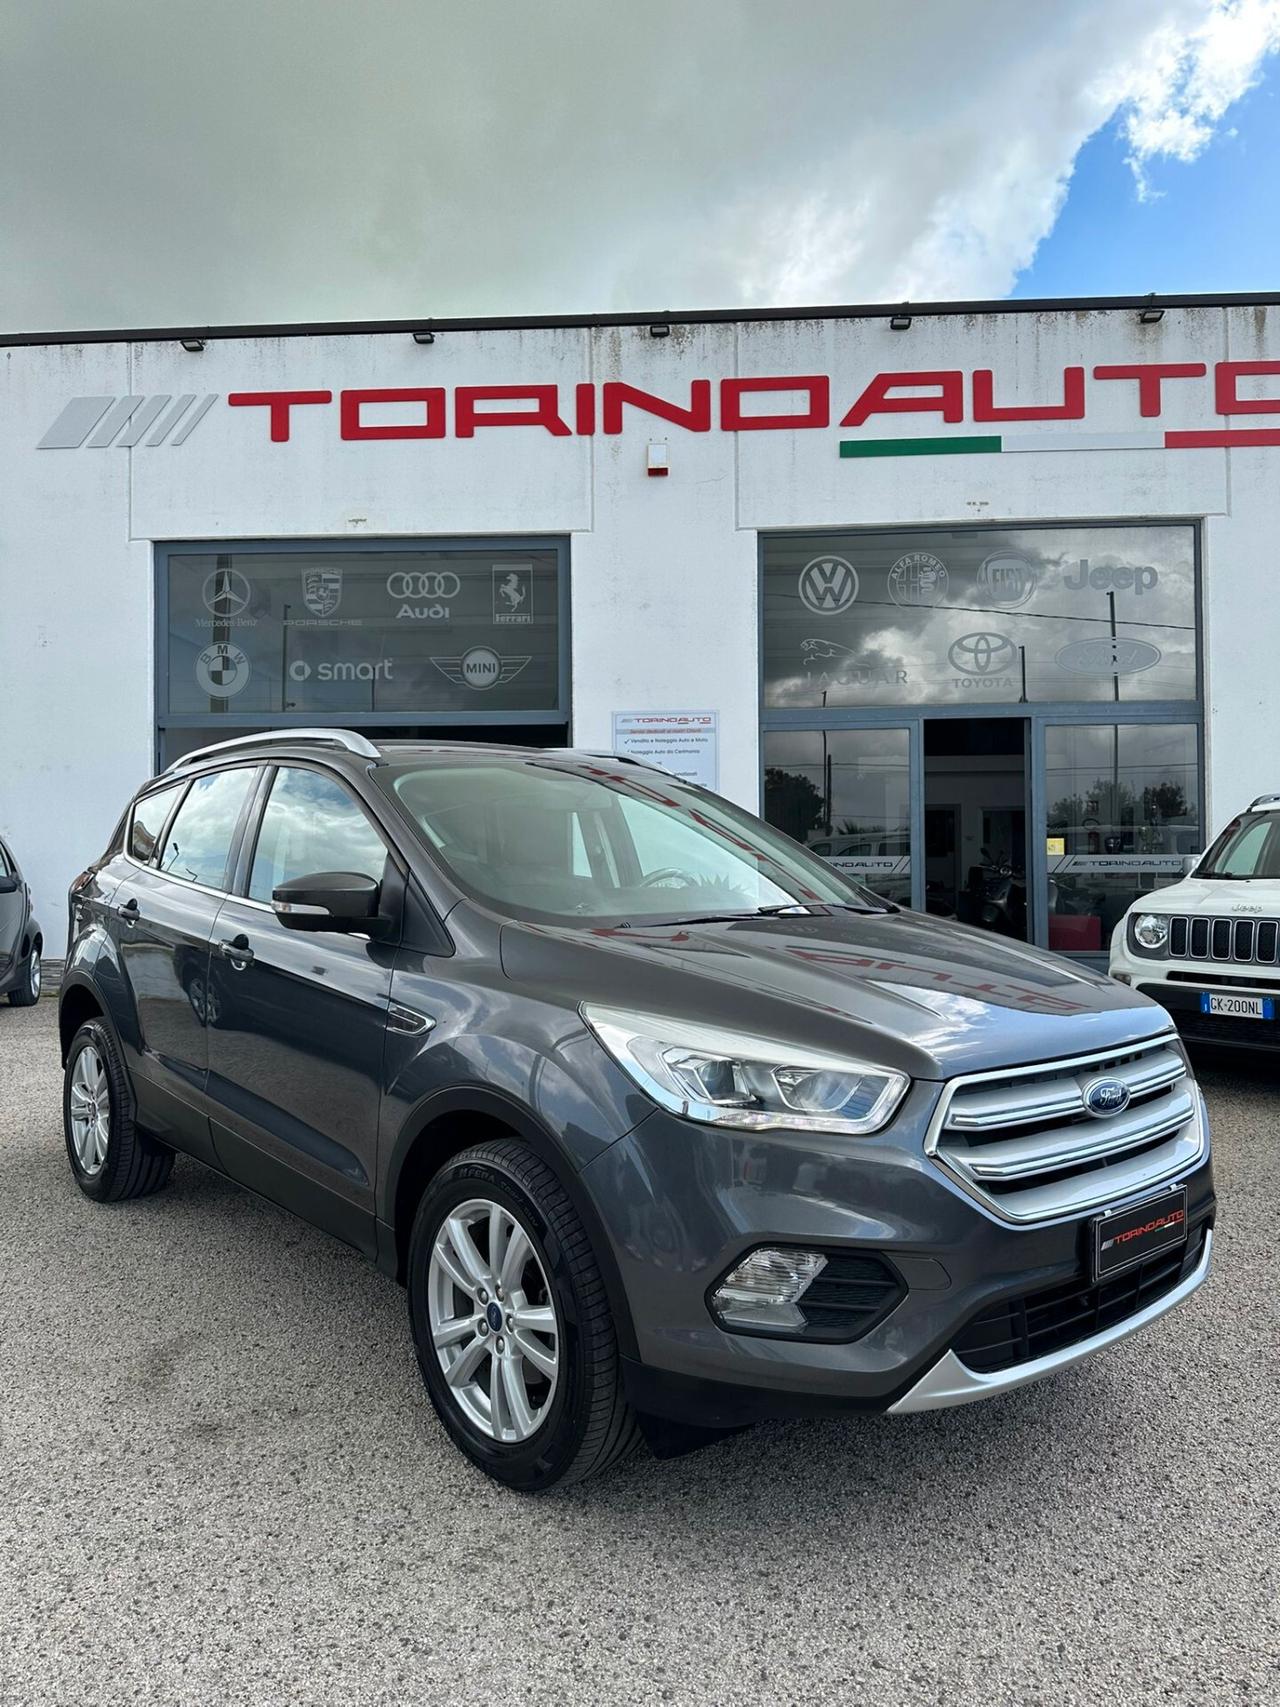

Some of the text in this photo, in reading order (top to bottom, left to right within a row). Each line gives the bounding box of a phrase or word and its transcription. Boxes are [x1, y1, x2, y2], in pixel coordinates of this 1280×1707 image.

[891, 554, 946, 580] ALFA ROMEO
[1063, 559, 1158, 595] Jeep
[992, 568, 1023, 592] FIAT
[396, 604, 450, 619] Audi
[200, 645, 246, 665] BMW
[317, 659, 394, 681] smart
[466, 662, 496, 674] MINI
[806, 670, 909, 685] JAGUAR
[952, 678, 1014, 689] TOYOTA
[635, 716, 712, 724] TORINOAUTO
[1231, 904, 1264, 914] Jeep
[1099, 1086, 1122, 1106] Ford
[1113, 1209, 1185, 1245] TORINOAUTO
